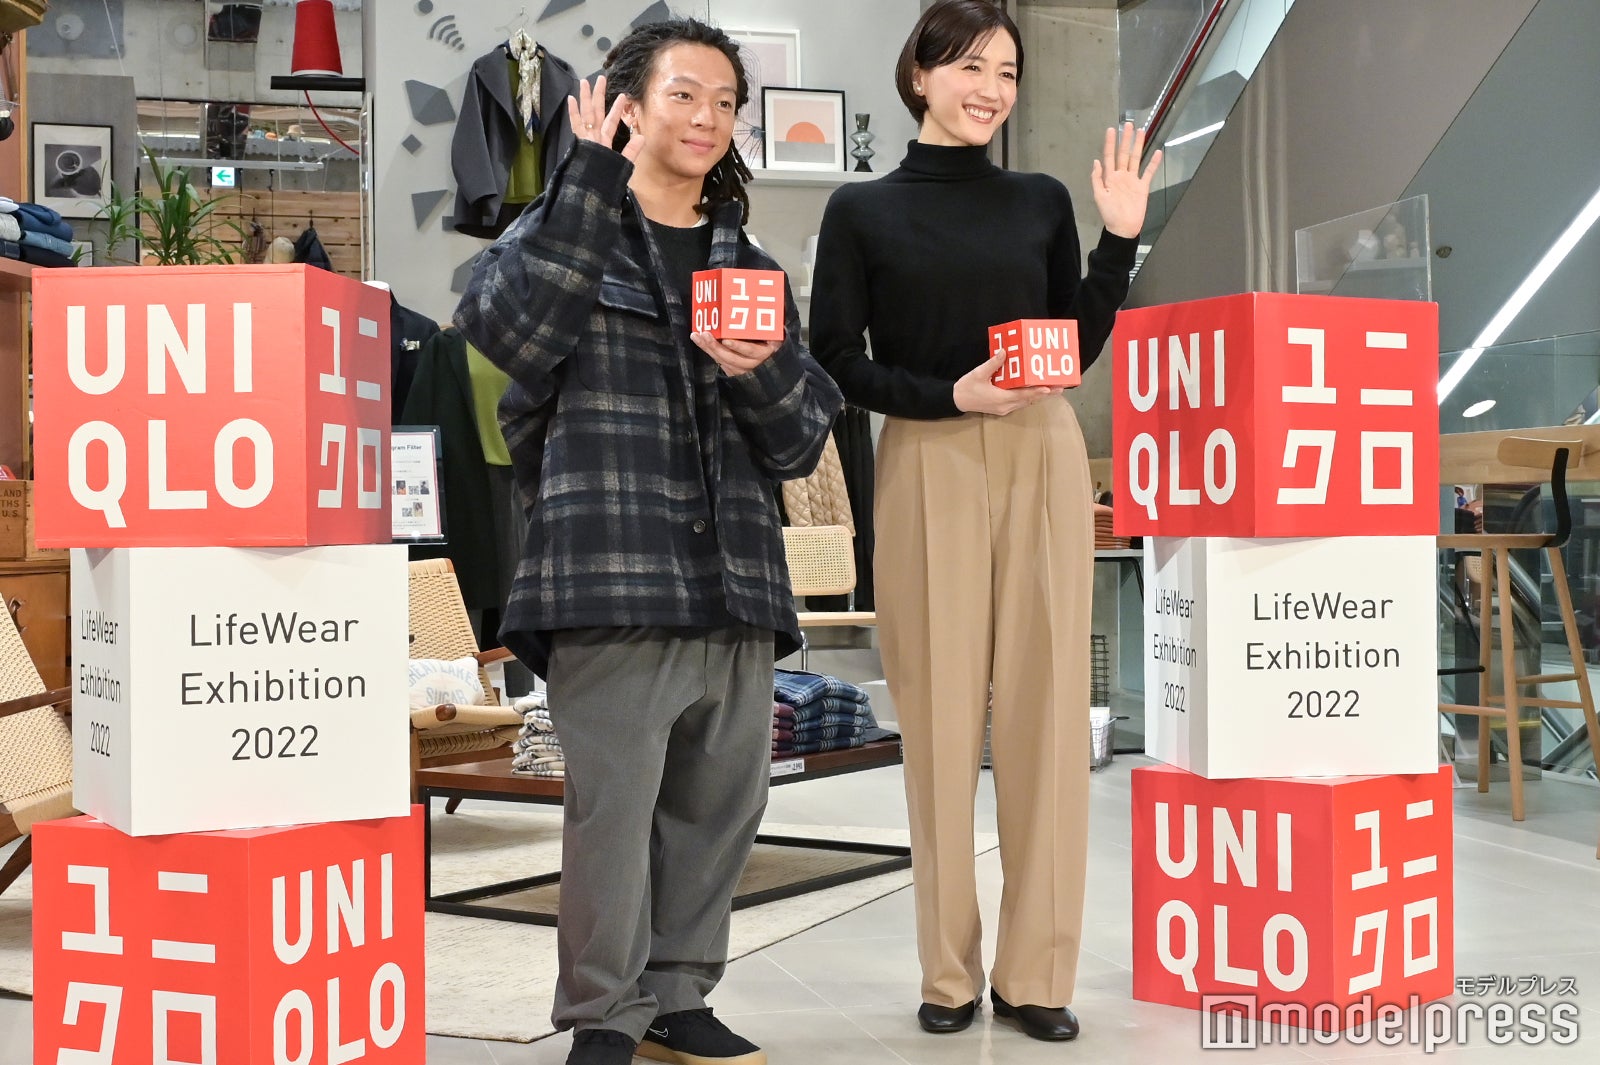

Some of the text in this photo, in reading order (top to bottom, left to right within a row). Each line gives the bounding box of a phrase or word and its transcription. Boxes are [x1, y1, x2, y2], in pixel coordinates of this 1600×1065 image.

[696, 278, 718, 304] UNI
[730, 277, 776, 303] ユニ
[695, 306, 719, 336] QLO
[728, 306, 776, 331] クロ
[67, 302, 253, 395] UNI
[320, 306, 380, 401] ユニ
[1028, 327, 1069, 350] UNI
[1030, 354, 1074, 381] QLO
[1128, 329, 1225, 413] UNI
[1282, 327, 1413, 406] ユニ
[68, 418, 273, 528] QLO
[318, 423, 381, 509] クロ
[1128, 428, 1237, 520] QLO
[1277, 429, 1413, 505] クロ
[0, 489, 22, 498] AND
[1154, 588, 1195, 620] LifeWear
[1254, 592, 1394, 621] LifeWear
[80, 608, 119, 646] LifeWear
[190, 611, 360, 647] LifeWear
[1153, 633, 1197, 668] Exhibition
[1246, 641, 1400, 670] Exhibition
[80, 662, 122, 704] Exhibition
[181, 667, 366, 705] Exhibition
[1164, 682, 1186, 714] 2022
[1287, 690, 1360, 718] 2022
[90, 720, 111, 758] 2022
[231, 724, 319, 761] 2022
[1155, 802, 1292, 892] UNI
[1351, 799, 1438, 891] ユニ
[62, 865, 216, 964] ユニ
[272, 853, 393, 965] UNI
[1156, 899, 1309, 992] QLO
[1348, 896, 1438, 995] クロ
[56, 981, 216, 1065] クロ
